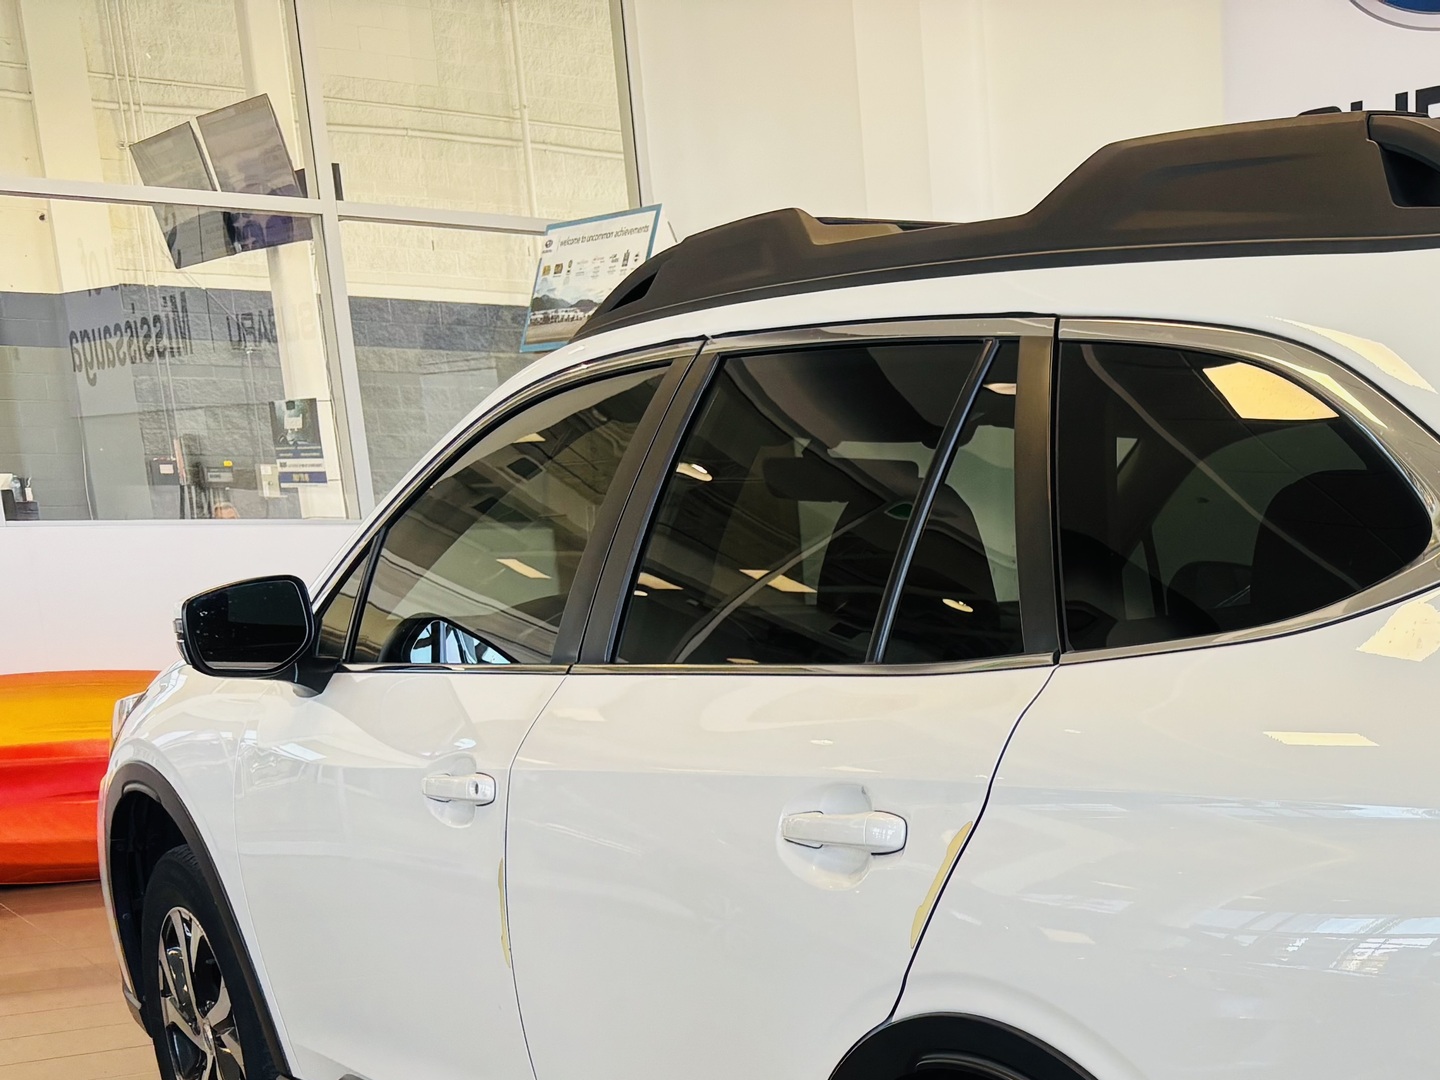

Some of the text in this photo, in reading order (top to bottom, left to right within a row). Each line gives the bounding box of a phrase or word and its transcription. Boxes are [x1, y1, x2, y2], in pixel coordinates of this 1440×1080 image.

[560, 236, 580, 246] welcome
[587, 232, 614, 242] uncommon
[614, 225, 650, 238] achievements
